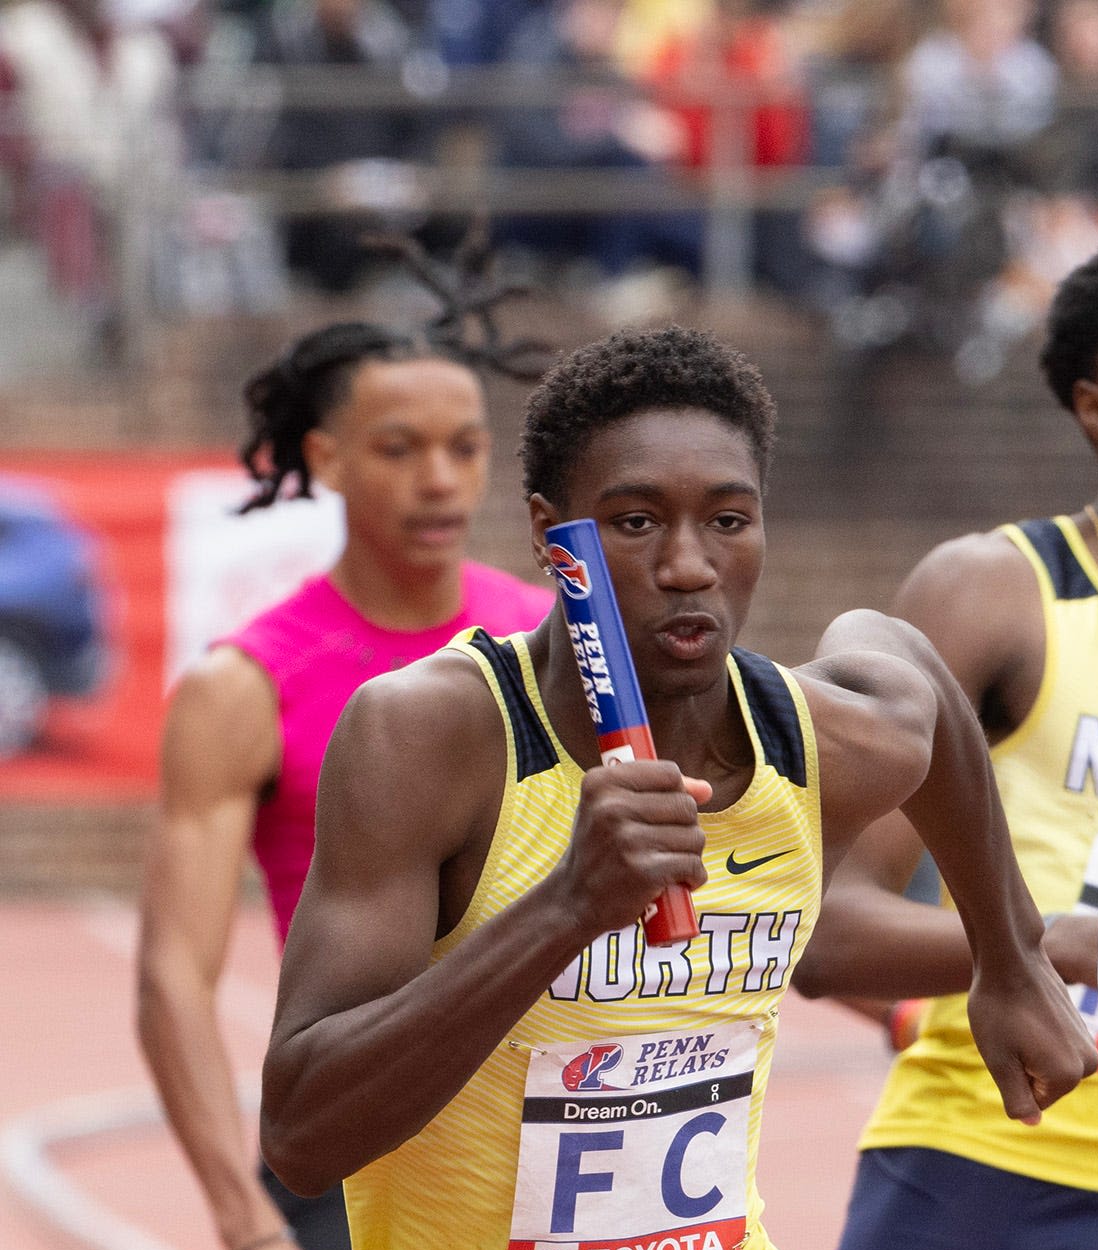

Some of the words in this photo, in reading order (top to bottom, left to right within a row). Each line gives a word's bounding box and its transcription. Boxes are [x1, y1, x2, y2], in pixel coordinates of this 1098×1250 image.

[580, 621, 614, 696] PENN
[630, 1047, 729, 1087] RELAYS
[636, 1034, 714, 1063] PENN
[563, 1104, 628, 1120] Dream
[631, 1099, 662, 1118] On.
[549, 1130, 625, 1234] F
[661, 1111, 727, 1218] C
